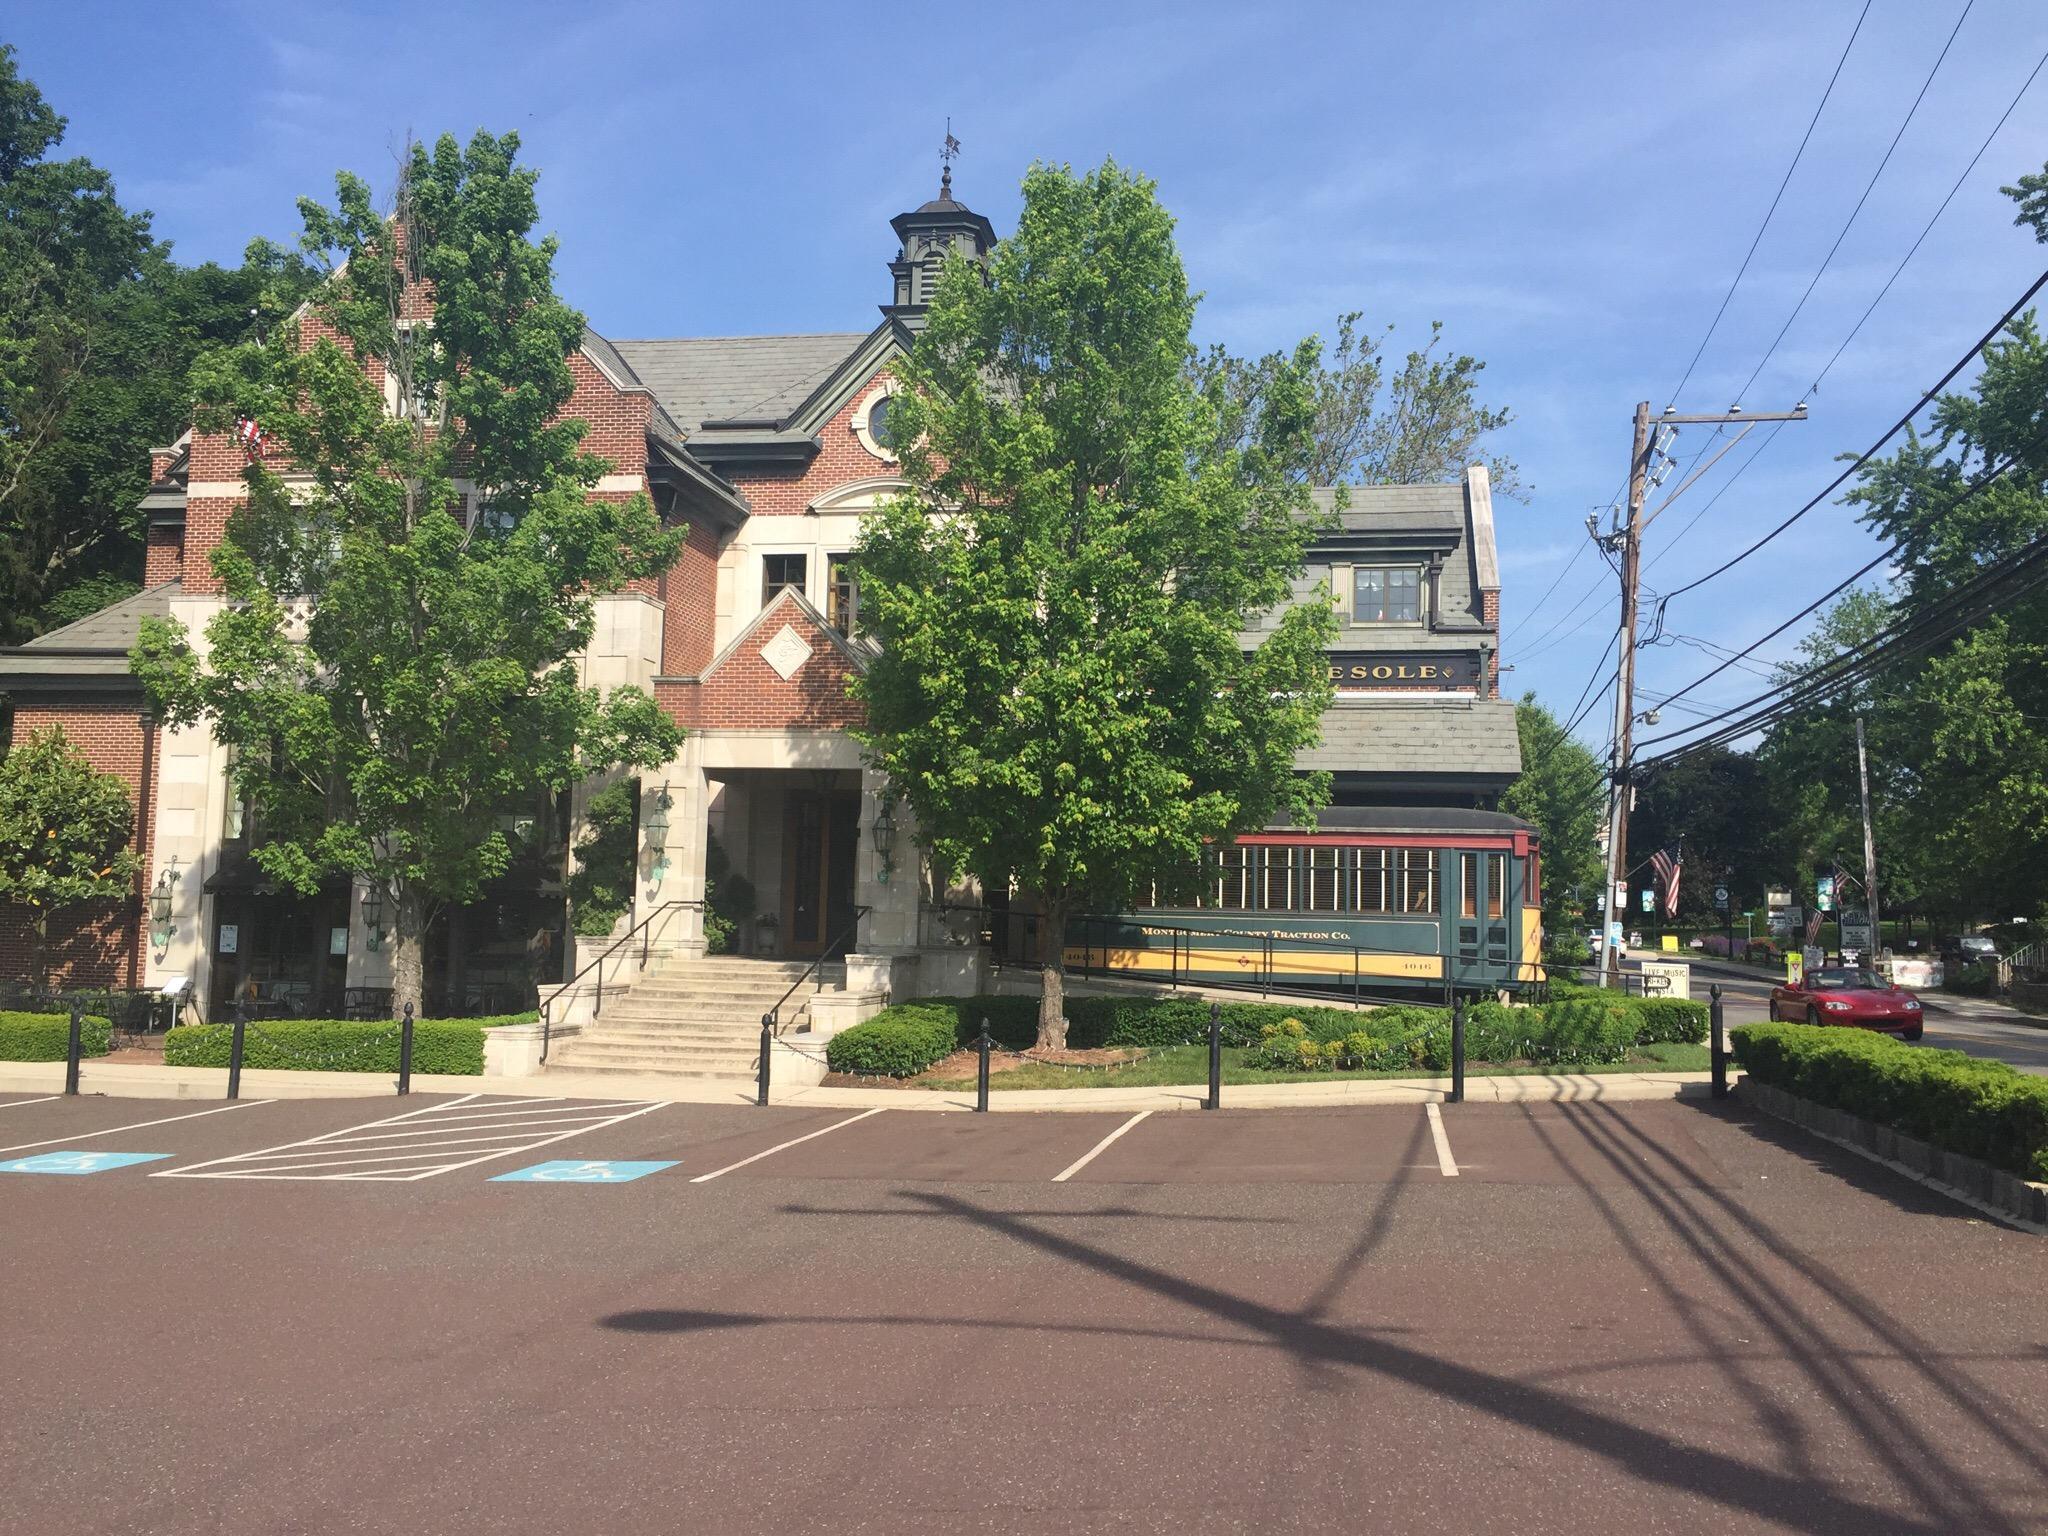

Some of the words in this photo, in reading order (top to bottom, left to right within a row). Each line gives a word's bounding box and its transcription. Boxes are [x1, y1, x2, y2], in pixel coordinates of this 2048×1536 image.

[1787, 917, 1801, 925] 35
[1272, 930, 1329, 939] TRACTION
[1663, 969, 1686, 977] MUSIC
